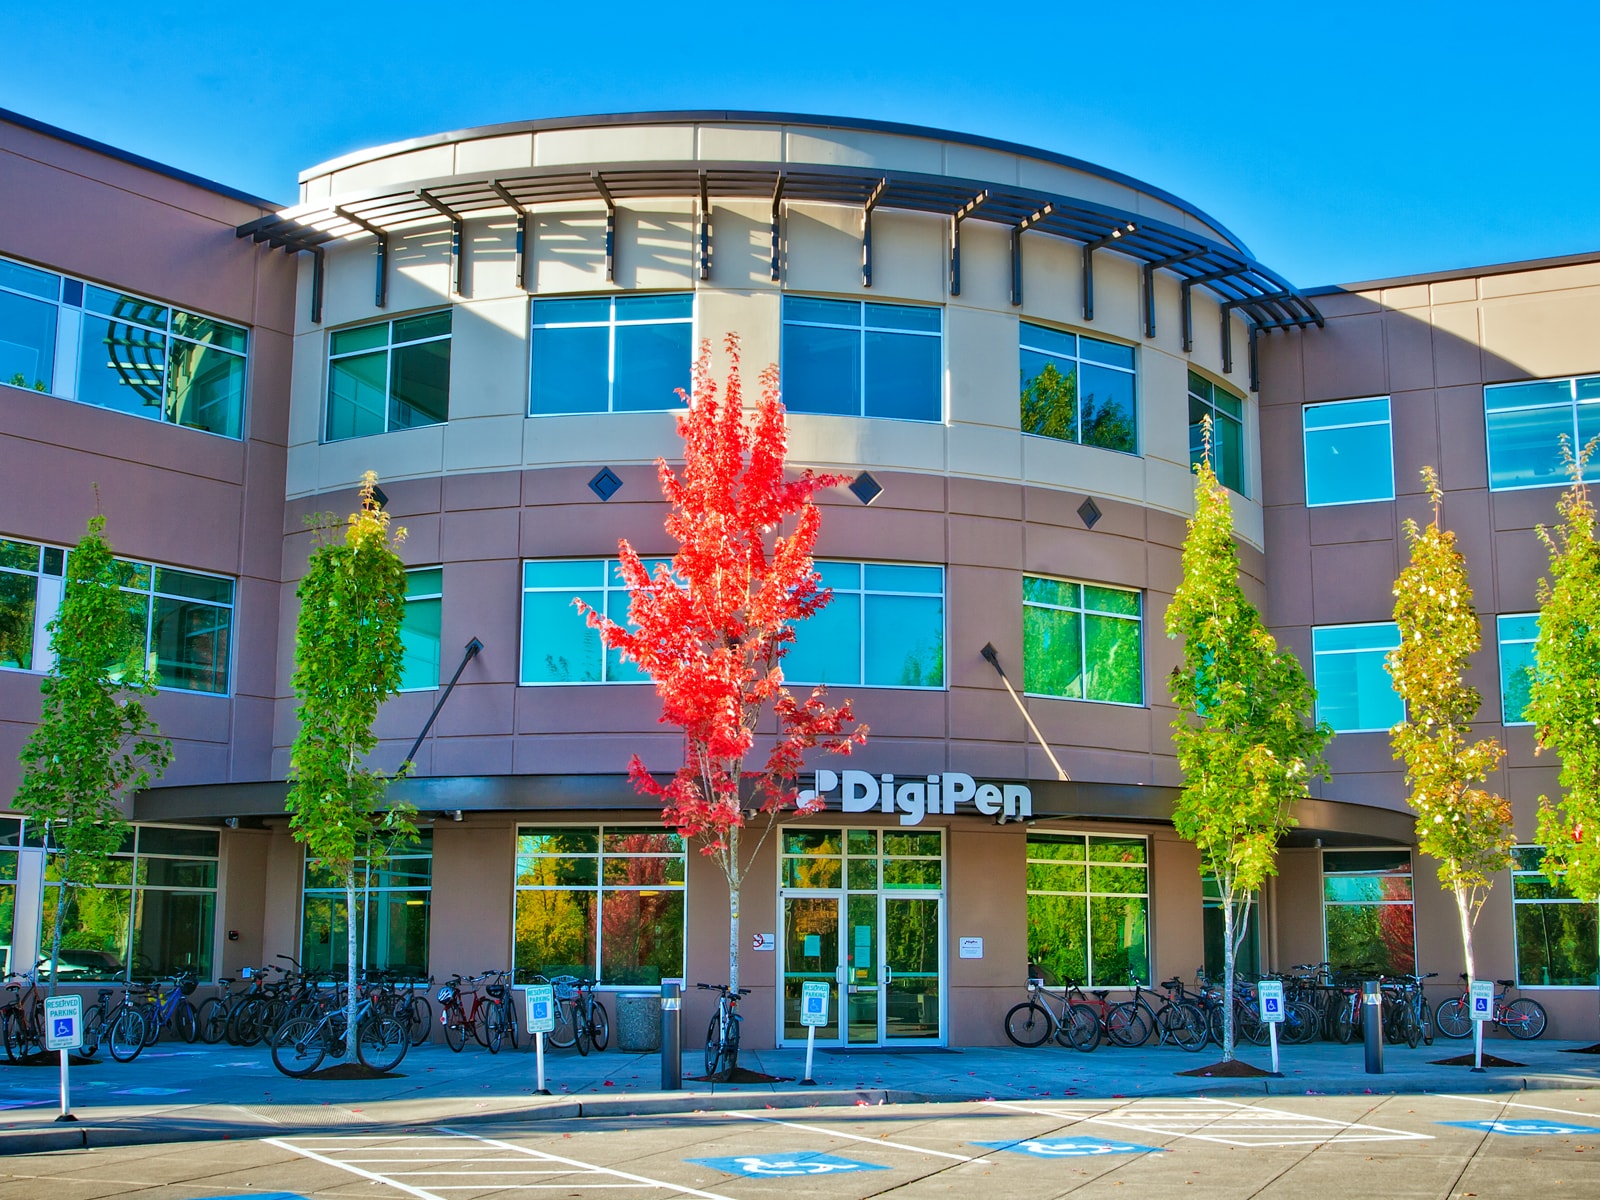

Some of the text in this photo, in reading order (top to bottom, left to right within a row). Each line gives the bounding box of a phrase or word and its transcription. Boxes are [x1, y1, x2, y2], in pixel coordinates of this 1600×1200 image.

[842, 770, 1031, 825] DigiPen
[46, 999, 78, 1008] RESERVED
[50, 1008, 77, 1016] PARKING
